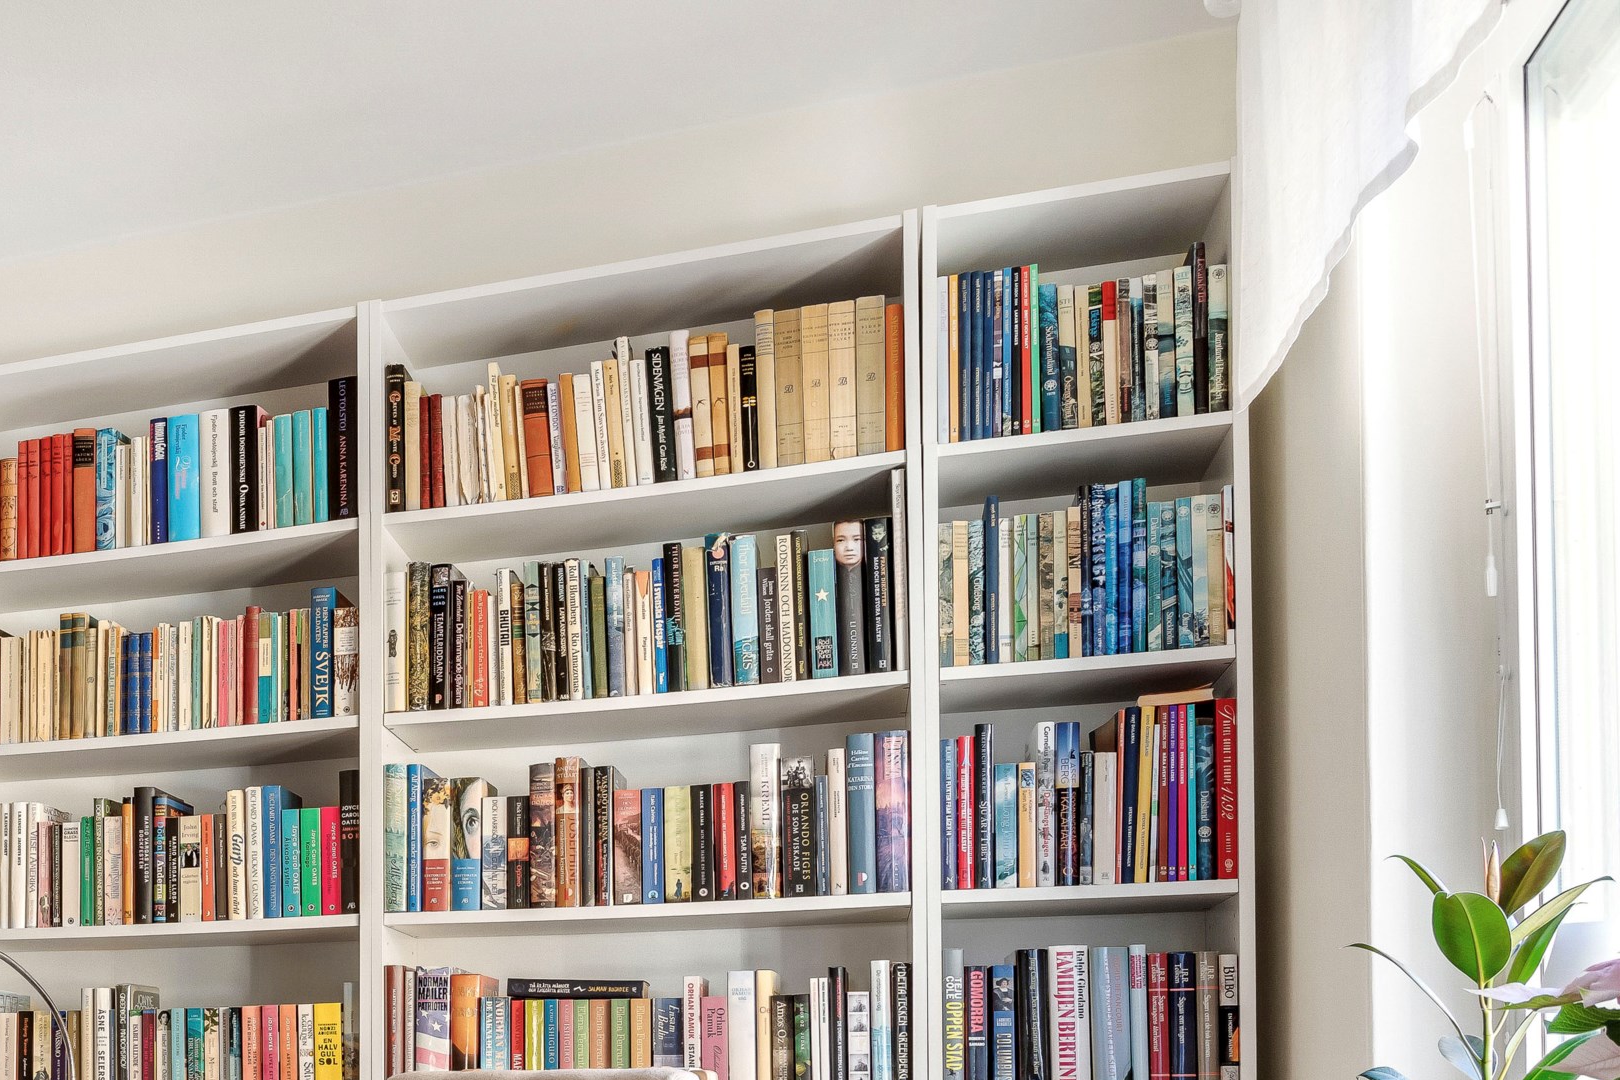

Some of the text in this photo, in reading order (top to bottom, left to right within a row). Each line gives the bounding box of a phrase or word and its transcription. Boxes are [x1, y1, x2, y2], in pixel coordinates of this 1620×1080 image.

[1045, 326, 1057, 376] Södermanland
[652, 353, 664, 410] SIDENVÄGEN
[210, 434, 218, 468] Dostojevskij
[338, 380, 347, 506] LEO TOLSTOJ ANNA KARENINA
[569, 565, 578, 581] Rolf
[569, 585, 579, 625] Blomberg
[778, 538, 792, 683] RÖDSKINN OCH MADONNOR
[500, 610, 510, 646] BHUTAN
[764, 599, 775, 660] Jorden skall gråta
[851, 630, 859, 659] CUNXIN
[1166, 612, 1174, 644] Stockholm
[436, 613, 444, 683] TEMPELRIDDARNA
[315, 651, 331, 706] ŠVEJK
[572, 649, 581, 693] Amazonas
[1061, 758, 1070, 784] BERG
[600, 775, 609, 840] VASADÖTTRARNA
[761, 781, 770, 825] KREML
[792, 804, 799, 814] DE
[1200, 791, 1210, 821] Dalsland
[1220, 787, 1234, 820] 1492
[230, 834, 243, 865] Garp
[801, 794, 811, 880] ORLANDO FIGES
[418, 977, 448, 987] NORMAN
[418, 988, 448, 1000] MAILER
[946, 976, 954, 999] COLE
[954, 977, 962, 999] TEJU
[1054, 951, 1076, 1018] FAMILJEN
[1076, 951, 1086, 1019] Ralph Giordano
[1224, 966, 1236, 999] BILBO
[636, 1005, 644, 1030] Elena
[970, 971, 984, 1032] GOMORRA
[98, 1009, 106, 1032] ÅSNE
[577, 1006, 585, 1031] Elena
[596, 1006, 604, 1031] Elena
[616, 1006, 624, 1031] Elena
[657, 1015, 668, 1040] Berlin
[668, 1005, 679, 1032] Ensam
[707, 1008, 716, 1038] Pamuk
[716, 1007, 725, 1036] Orhan
[777, 1001, 786, 1044] Amos Oz
[548, 1024, 556, 1063] ISHIGURO
[946, 1002, 964, 1070] ÖPPEN STAD
[997, 1033, 1012, 1080] COLUMBUS
